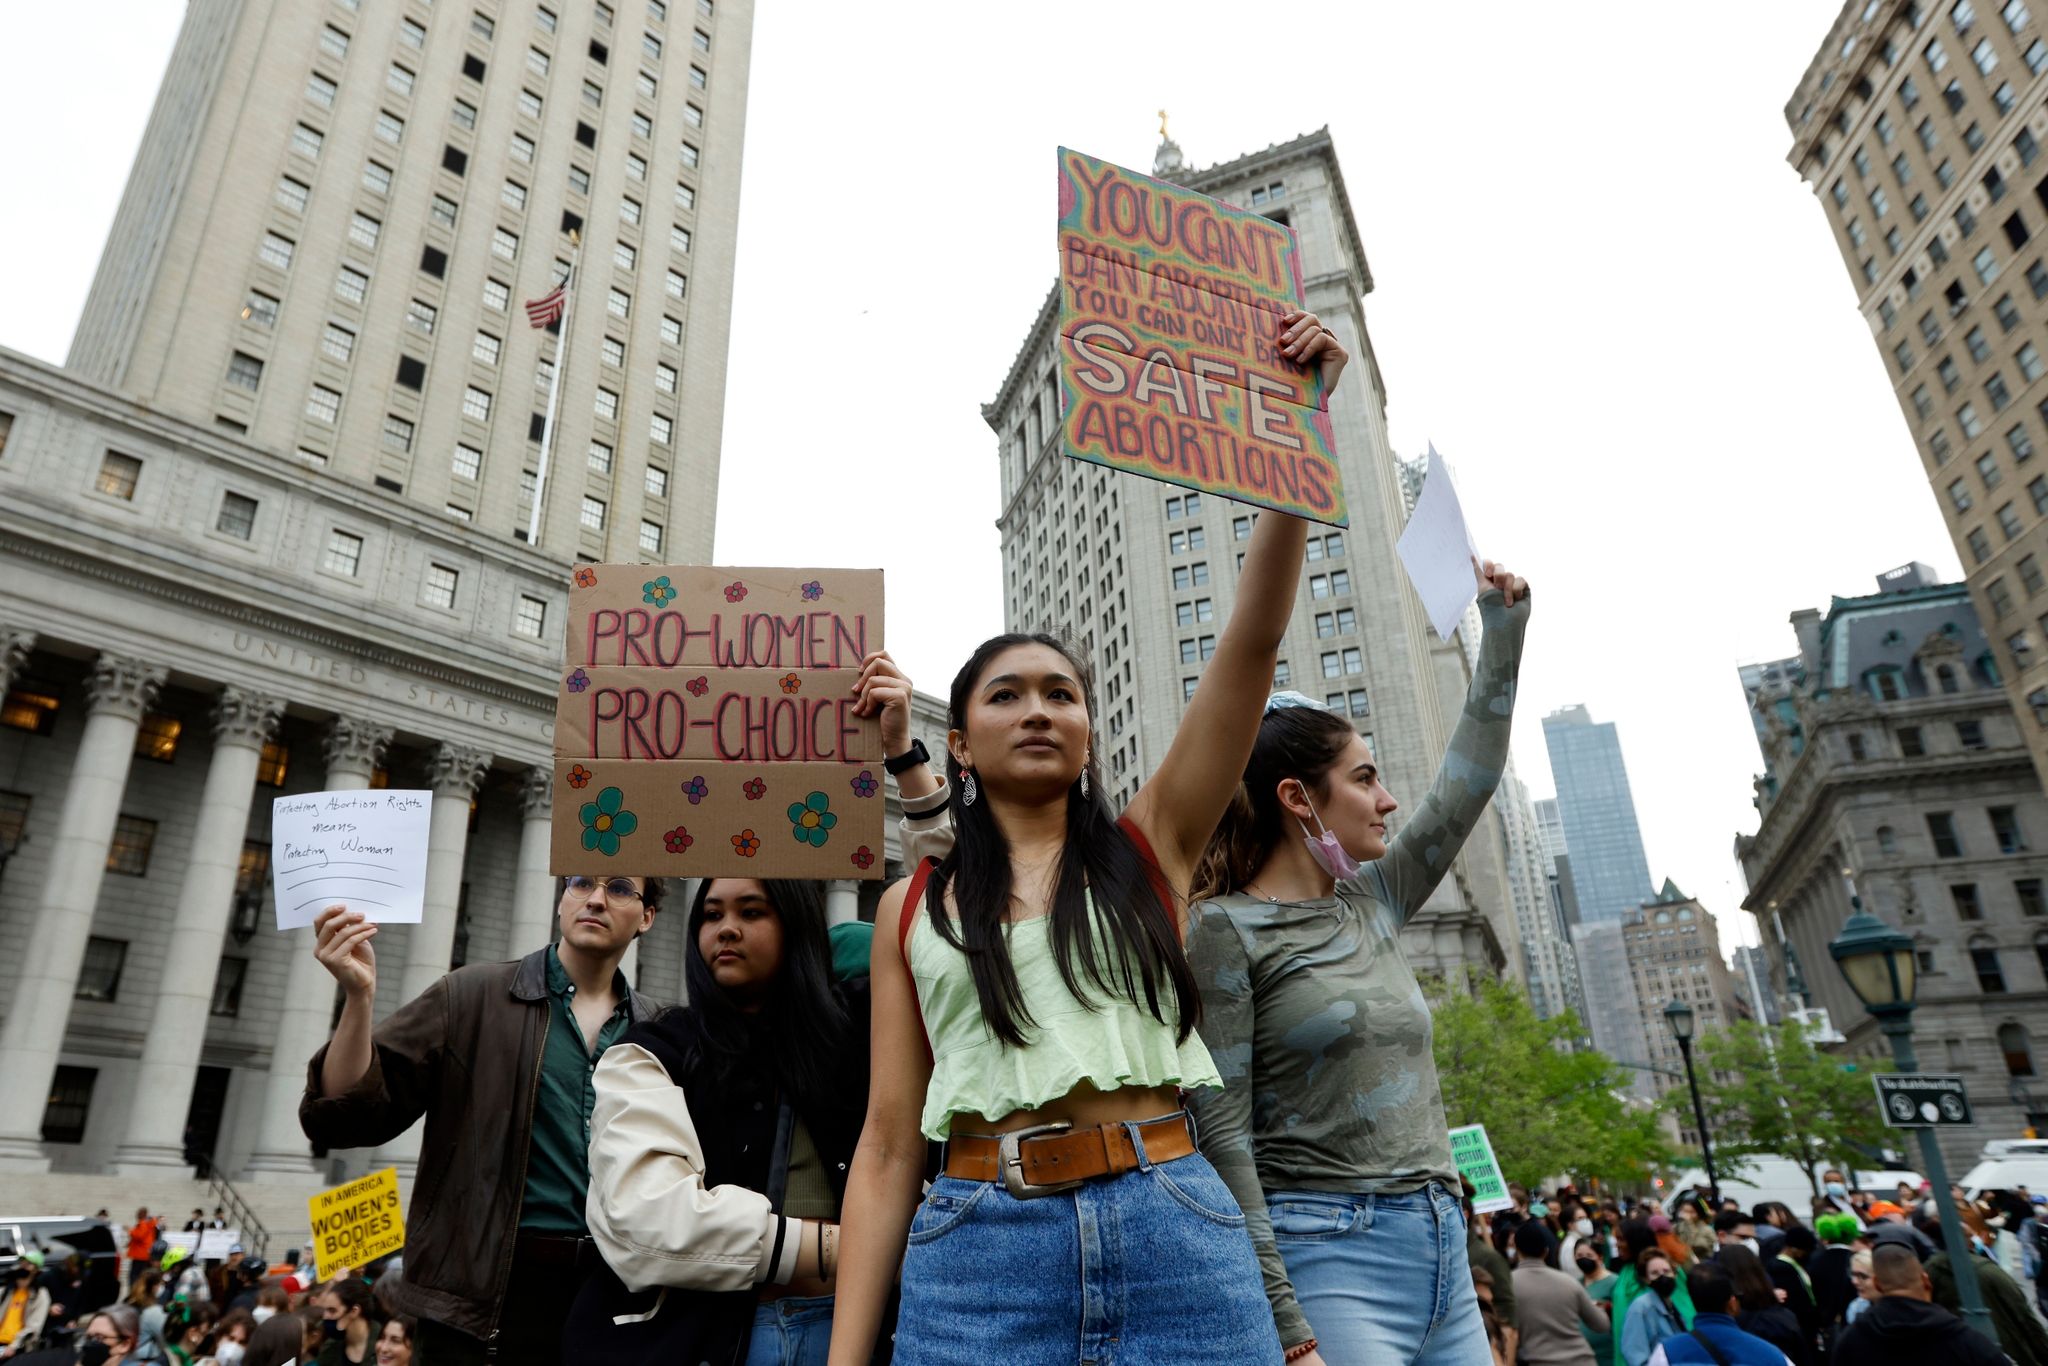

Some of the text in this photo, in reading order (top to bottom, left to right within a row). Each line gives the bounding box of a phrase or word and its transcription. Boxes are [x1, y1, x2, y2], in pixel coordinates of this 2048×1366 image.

[1073, 159, 1173, 247] YOU
[1068, 236, 1138, 294] BAN
[1067, 280, 1129, 320] YOU
[1138, 304, 1186, 336] CAN
[1193, 319, 1247, 353] ONLY
[1072, 322, 1304, 451] SAFE
[1077, 402, 1334, 509] ABORTIONS
[587, 607, 868, 671] PRO-WOMEN
[232, 632, 510, 726] UNITED STATES
[588, 687, 864, 766] PRO-CHOICE
[273, 795, 423, 817] Protecting Abortion Rights
[311, 822, 357, 833] means
[282, 843, 329, 868] Protecting
[311, 1190, 398, 1238] WOMEN'S
[321, 1176, 384, 1208] IN AMERICA
[319, 1233, 402, 1278] UNDER ATTACK
[324, 1213, 392, 1255] BODIES
